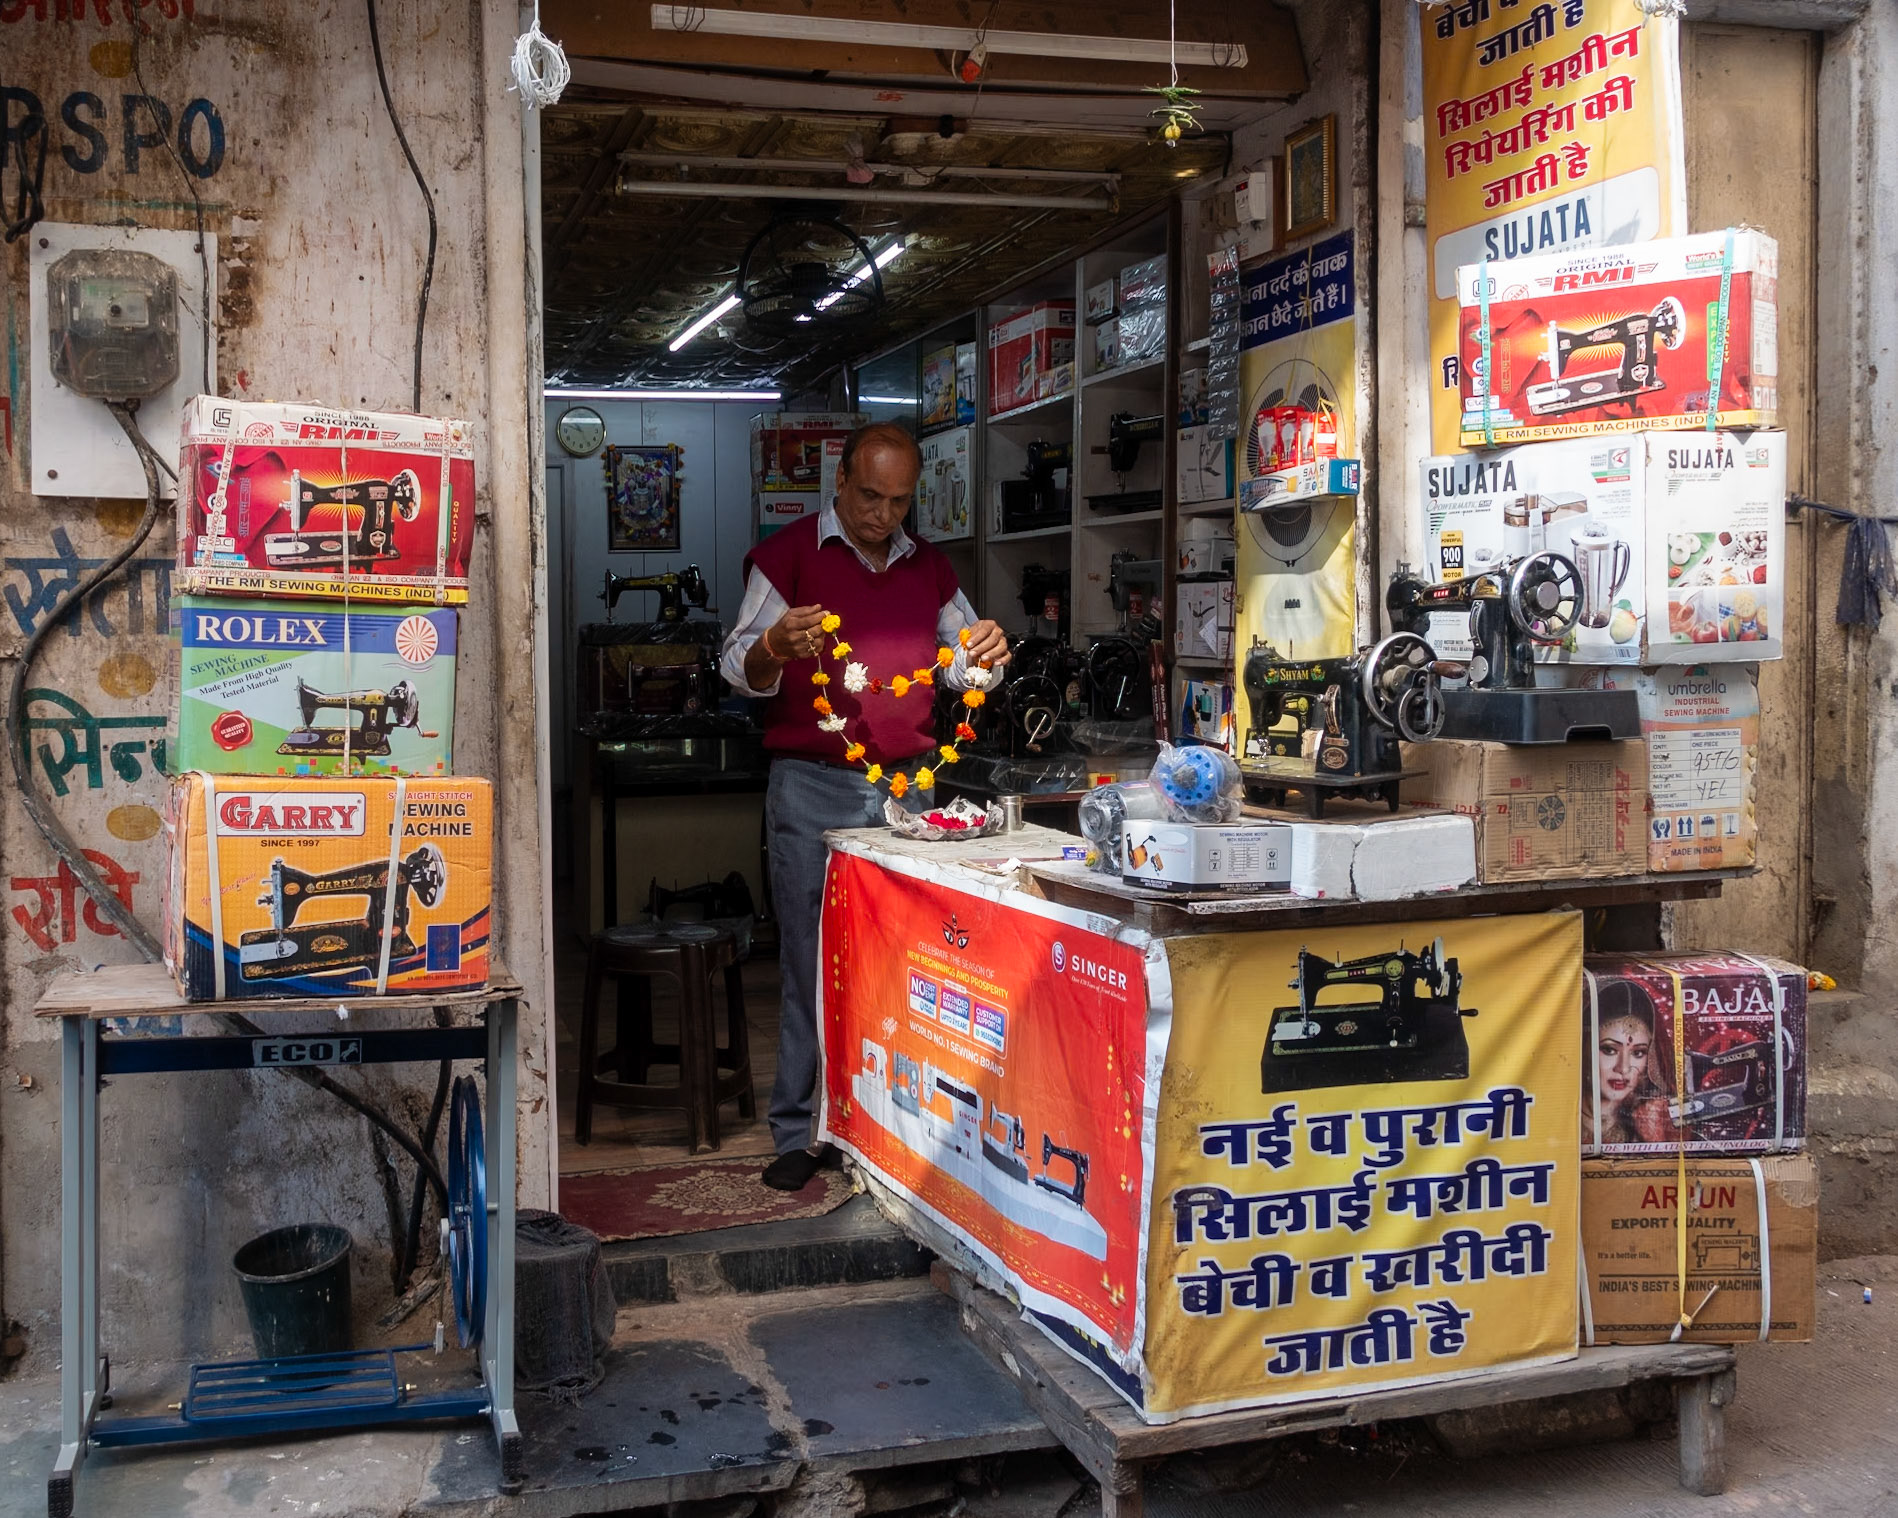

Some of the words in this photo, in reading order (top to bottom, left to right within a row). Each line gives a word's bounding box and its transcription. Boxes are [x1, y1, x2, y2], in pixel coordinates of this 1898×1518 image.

[1476, 4, 1557, 67] जाती
[1437, 63, 1534, 137] सिलाई
[1540, 25, 1641, 89] मशीन
[1445, 103, 1576, 179] रिपेयरिंग
[1582, 76, 1636, 121] की
[1483, 154, 1560, 208] जाती
[1562, 142, 1591, 180] है
[1485, 198, 1592, 261] SUJATA
[1556, 258, 1635, 274] ORIGINAL
[1567, 257, 1598, 265] SINCE
[1269, 265, 1292, 295] दर्द
[1312, 250, 1348, 278] नाक
[1553, 266, 1636, 292] RMI
[299, 424, 380, 441] RMI
[303, 416, 379, 429] ORIGINAL
[1476, 431, 1502, 441] TE
[1506, 430, 1530, 439] RMI
[1534, 423, 1593, 437] SEWING
[1596, 417, 1670, 431] MACHINES
[1668, 449, 1734, 469] SUJATA
[1429, 460, 1517, 498] SUJATA
[777, 503, 803, 513] Vinny
[1443, 547, 1461, 563] 900
[207, 576, 234, 587] THE
[239, 578, 265, 588] RMI
[269, 580, 326, 591] SEWING
[329, 583, 402, 596] MACHINES
[405, 589, 449, 601] (INDI)
[195, 615, 327, 645] ROLEX
[190, 654, 238, 676] SEWING
[214, 653, 270, 678] MACHINE
[1280, 668, 1309, 681] SHYAM
[200, 684, 222, 696] Made
[223, 676, 244, 689] From
[245, 668, 264, 682] High
[265, 660, 293, 677] Quality
[220, 685, 246, 699] Tested
[247, 675, 280, 691] Material
[1668, 679, 1727, 696] umbrella
[1664, 709, 1694, 717] SEWING
[1696, 707, 1730, 716] MACHINE
[1675, 697, 1720, 706] INDUSTRIAL
[438, 792, 473, 800] STITCH
[220, 796, 358, 831] GARRY
[260, 839, 294, 848] SINCE
[297, 839, 320, 848] 1997
[1671, 848, 1692, 856] MADE
[315, 878, 356, 891] GARRY
[917, 941, 950, 962] CELEBRATE
[950, 953, 962, 967] THE
[961, 957, 986, 975] SEASON
[986, 968, 995, 979] OF
[907, 949, 919, 962] NEW
[920, 955, 956, 978] BEGINNINGS
[956, 970, 970, 983] AND
[970, 975, 1009, 1000] PROSPERITY
[1072, 955, 1127, 991] SINGER
[911, 976, 926, 997] NO
[943, 991, 969, 1010] EXTENDED
[943, 1000, 969, 1018] WARRANTY
[1682, 986, 1788, 1015] BAJAJ
[975, 1007, 1002, 1024] CUSTOMER
[975, 1015, 996, 1030] SUPPORT
[261, 1043, 334, 1063] ECO
[909, 1020, 933, 1041] WORLD
[950, 1041, 979, 1063] SEWING
[980, 1055, 1005, 1079] BRAND
[1200, 1105, 1296, 1169] नई
[1307, 1113, 1353, 1156] व
[1360, 1087, 1533, 1168] पुरानी
[1621, 1143, 1653, 1152] WITH
[1173, 1170, 1377, 1243] सिलाई
[1386, 1158, 1555, 1218] मशीन
[1641, 1185, 1735, 1209] ARUN
[1611, 1217, 1669, 1230] EXPORT
[1616, 1251, 1637, 1260] better
[1177, 1253, 1300, 1317] बेची
[1309, 1256, 1354, 1298] व
[1361, 1224, 1552, 1294] खरीदी
[1598, 1280, 1639, 1293] INDIA'S
[1642, 1280, 1670, 1292] BEST
[1673, 1280, 1714, 1292] SWING
[1264, 1309, 1417, 1376] जाती
[1416, 1300, 1471, 1355] है
